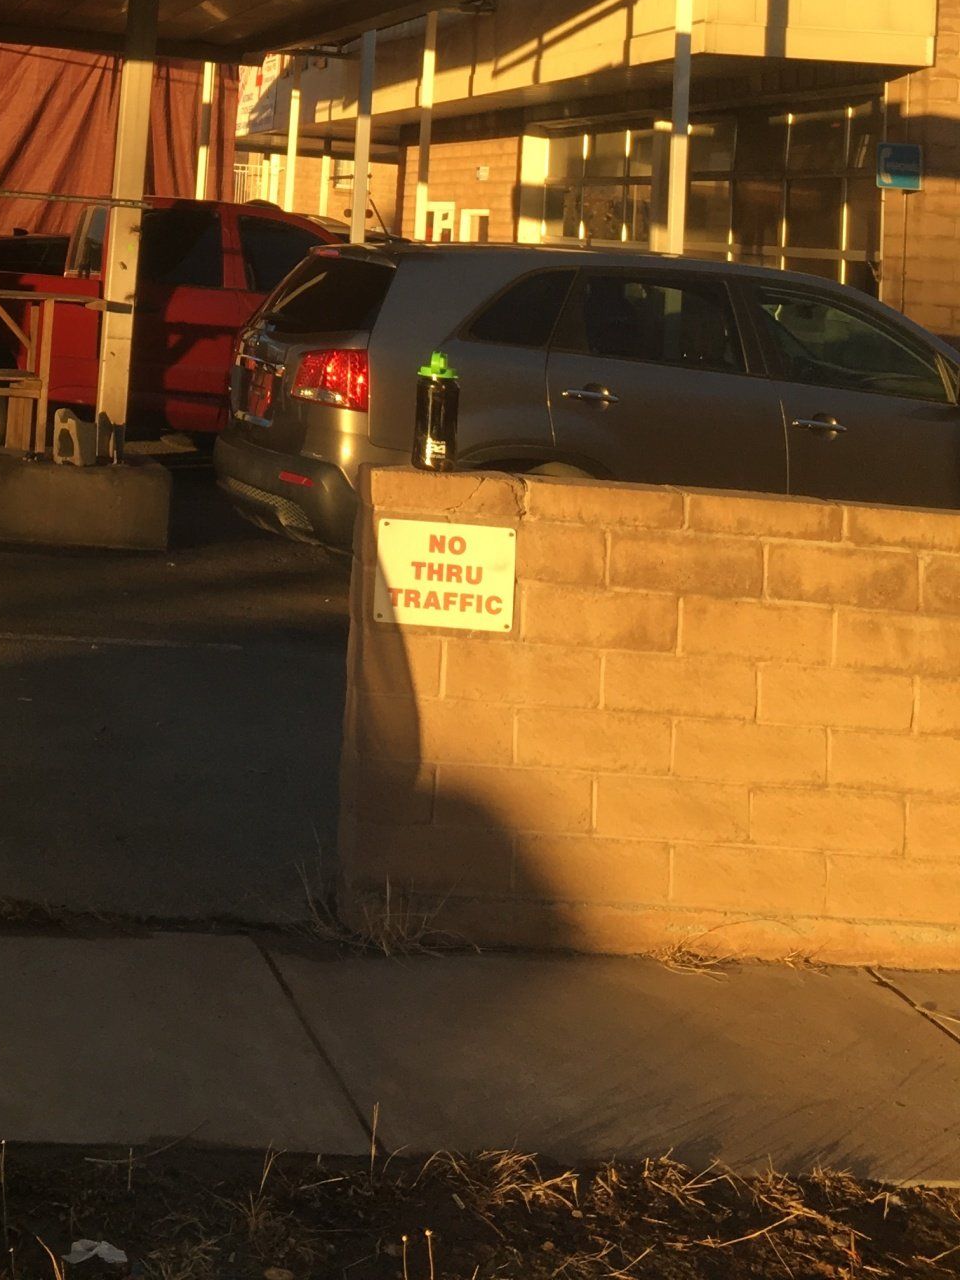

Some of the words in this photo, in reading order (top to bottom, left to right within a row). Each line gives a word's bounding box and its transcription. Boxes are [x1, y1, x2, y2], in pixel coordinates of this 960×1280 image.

[429, 534, 467, 555] NO
[411, 561, 483, 585] THRU
[388, 587, 503, 615] TRAFFIC
